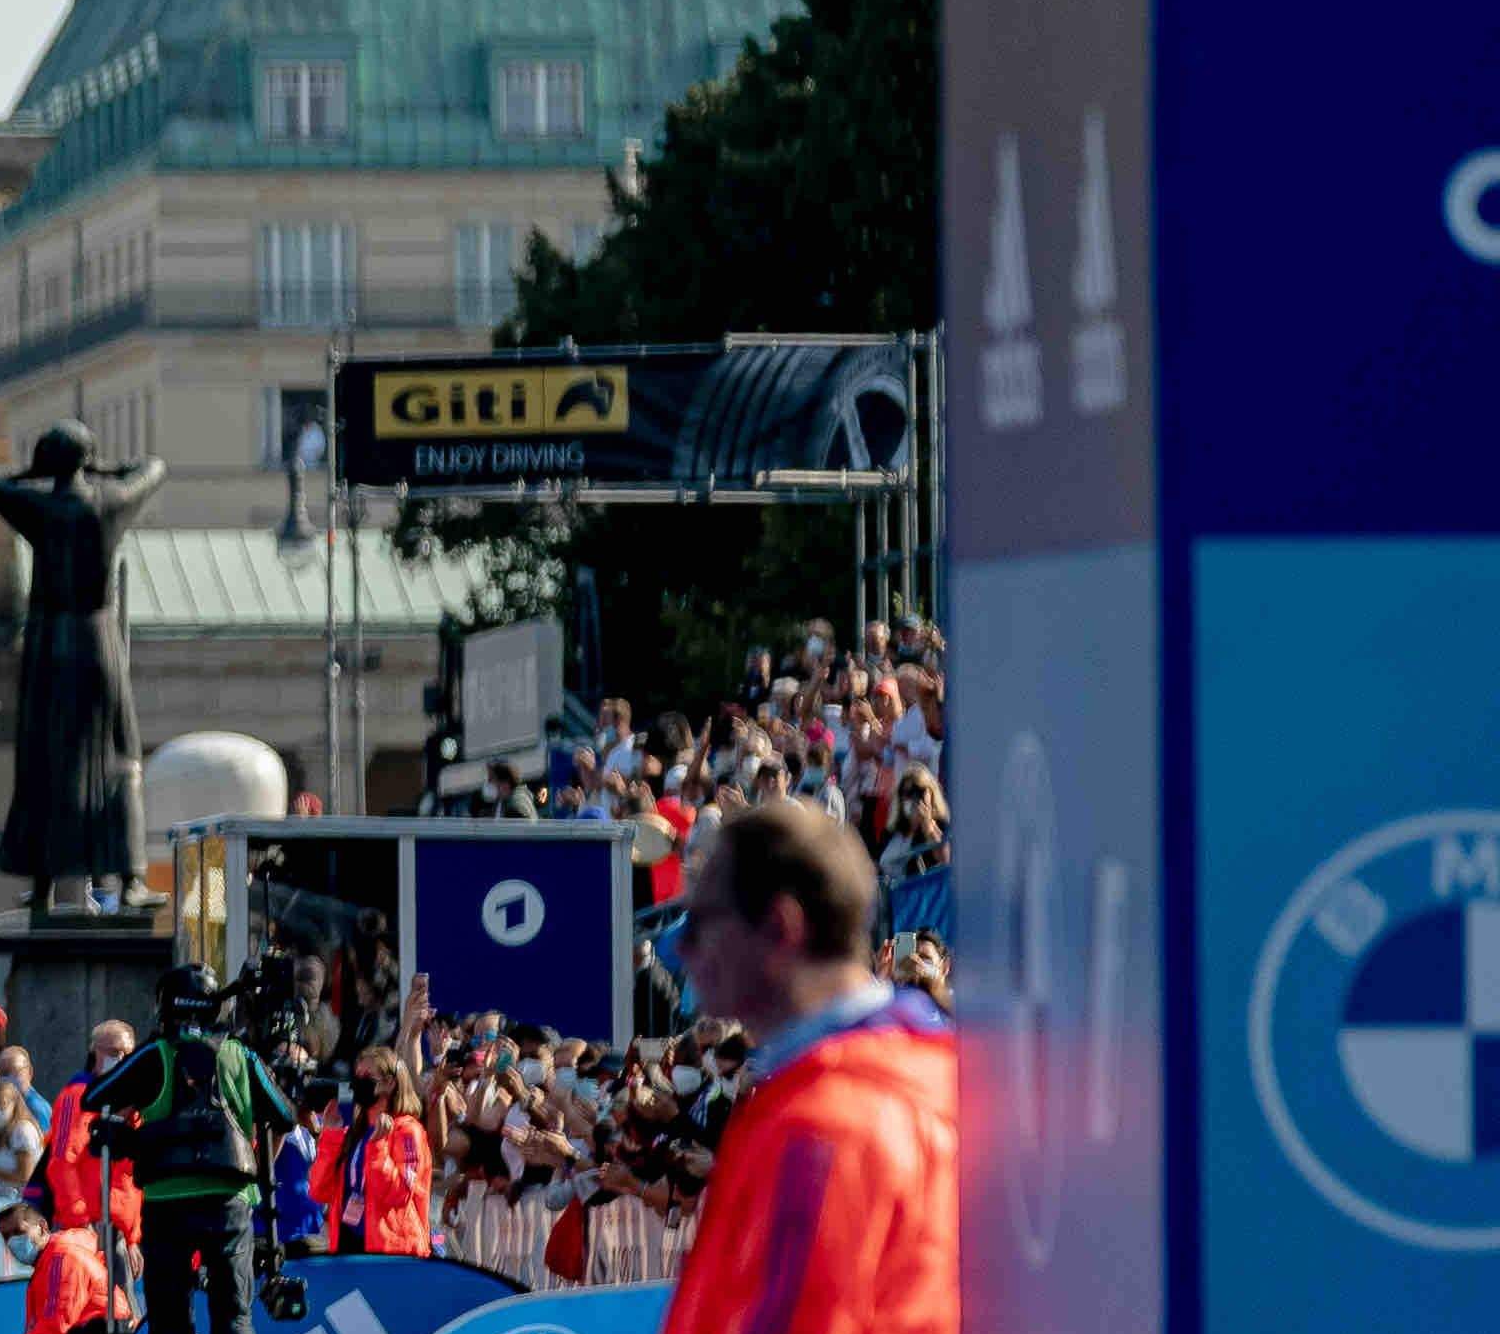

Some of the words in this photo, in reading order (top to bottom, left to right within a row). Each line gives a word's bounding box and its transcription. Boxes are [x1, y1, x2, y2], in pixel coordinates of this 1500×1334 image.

[391, 381, 527, 424] Giti
[414, 443, 487, 476] ENJOY
[492, 441, 585, 473] DRIVING
[1314, 833, 1500, 957] BM
